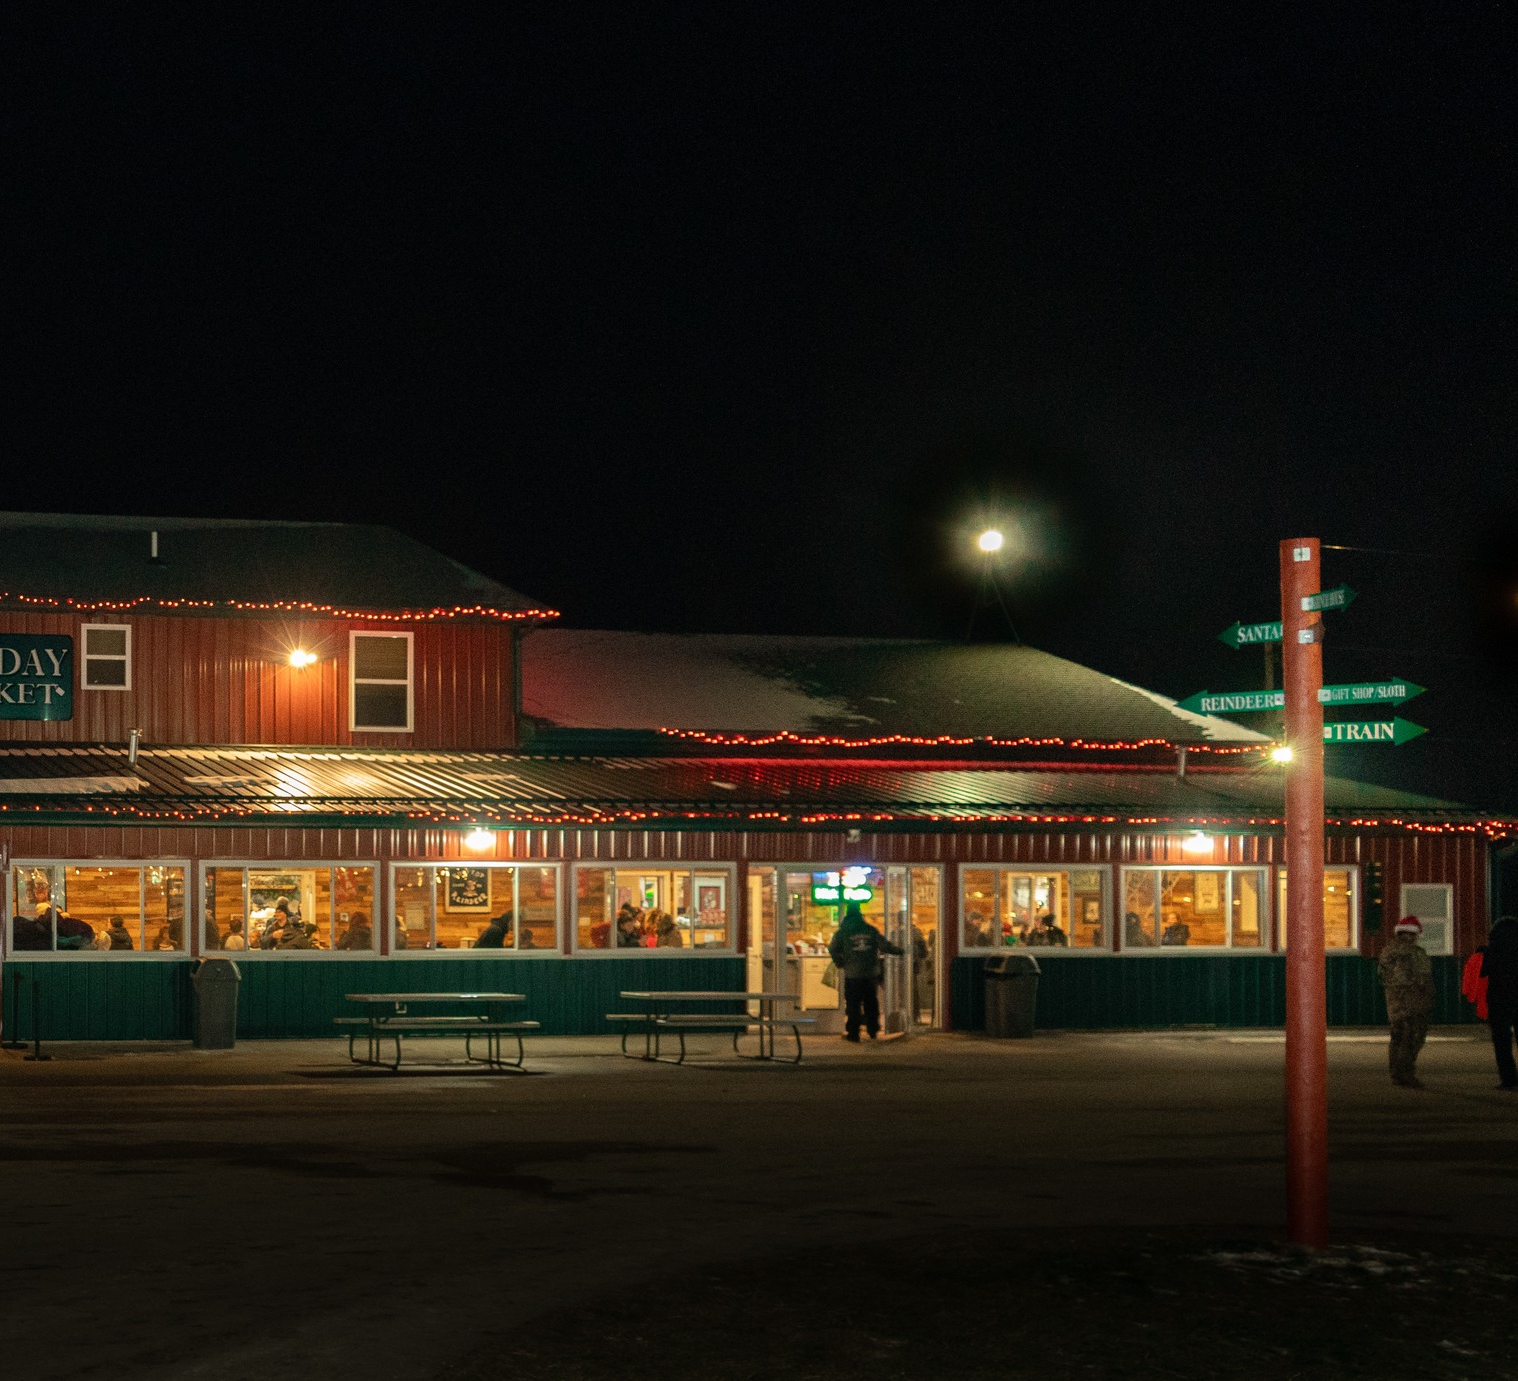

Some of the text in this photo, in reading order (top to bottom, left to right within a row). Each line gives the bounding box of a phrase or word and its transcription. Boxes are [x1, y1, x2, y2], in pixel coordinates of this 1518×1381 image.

[1332, 688, 1349, 700] GIFT
[1201, 694, 1275, 712] REINDEER
[1333, 723, 1394, 740] TRAIN
